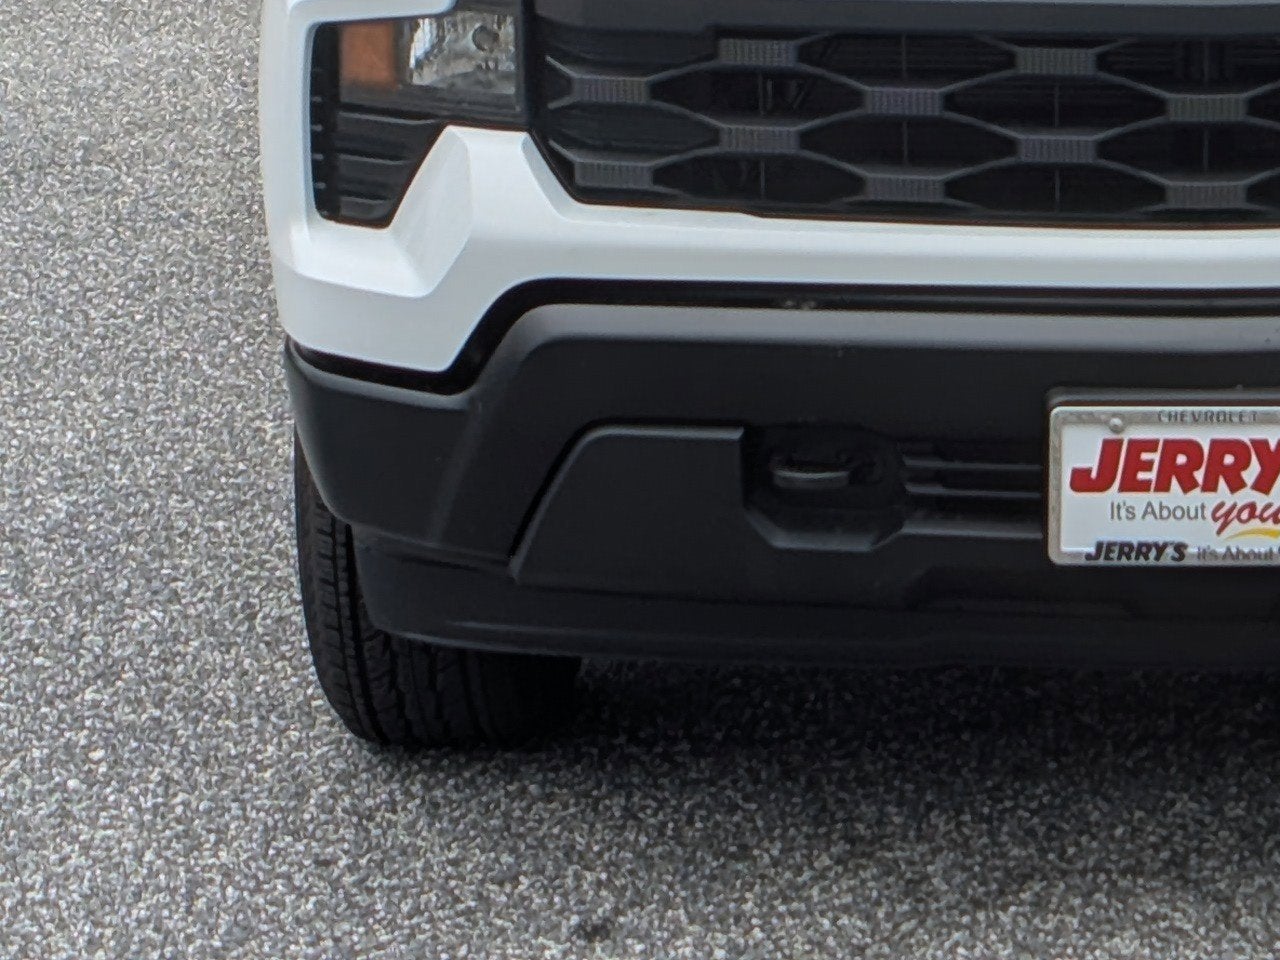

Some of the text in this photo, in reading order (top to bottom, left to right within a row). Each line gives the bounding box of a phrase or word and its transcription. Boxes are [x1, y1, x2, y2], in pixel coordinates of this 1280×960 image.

[1157, 409, 1258, 423] CHEVROLET
[1110, 501, 1136, 521] It's
[1141, 501, 1206, 521] About
[1084, 541, 1189, 563] JERRY'S
[1221, 546, 1274, 562] About
